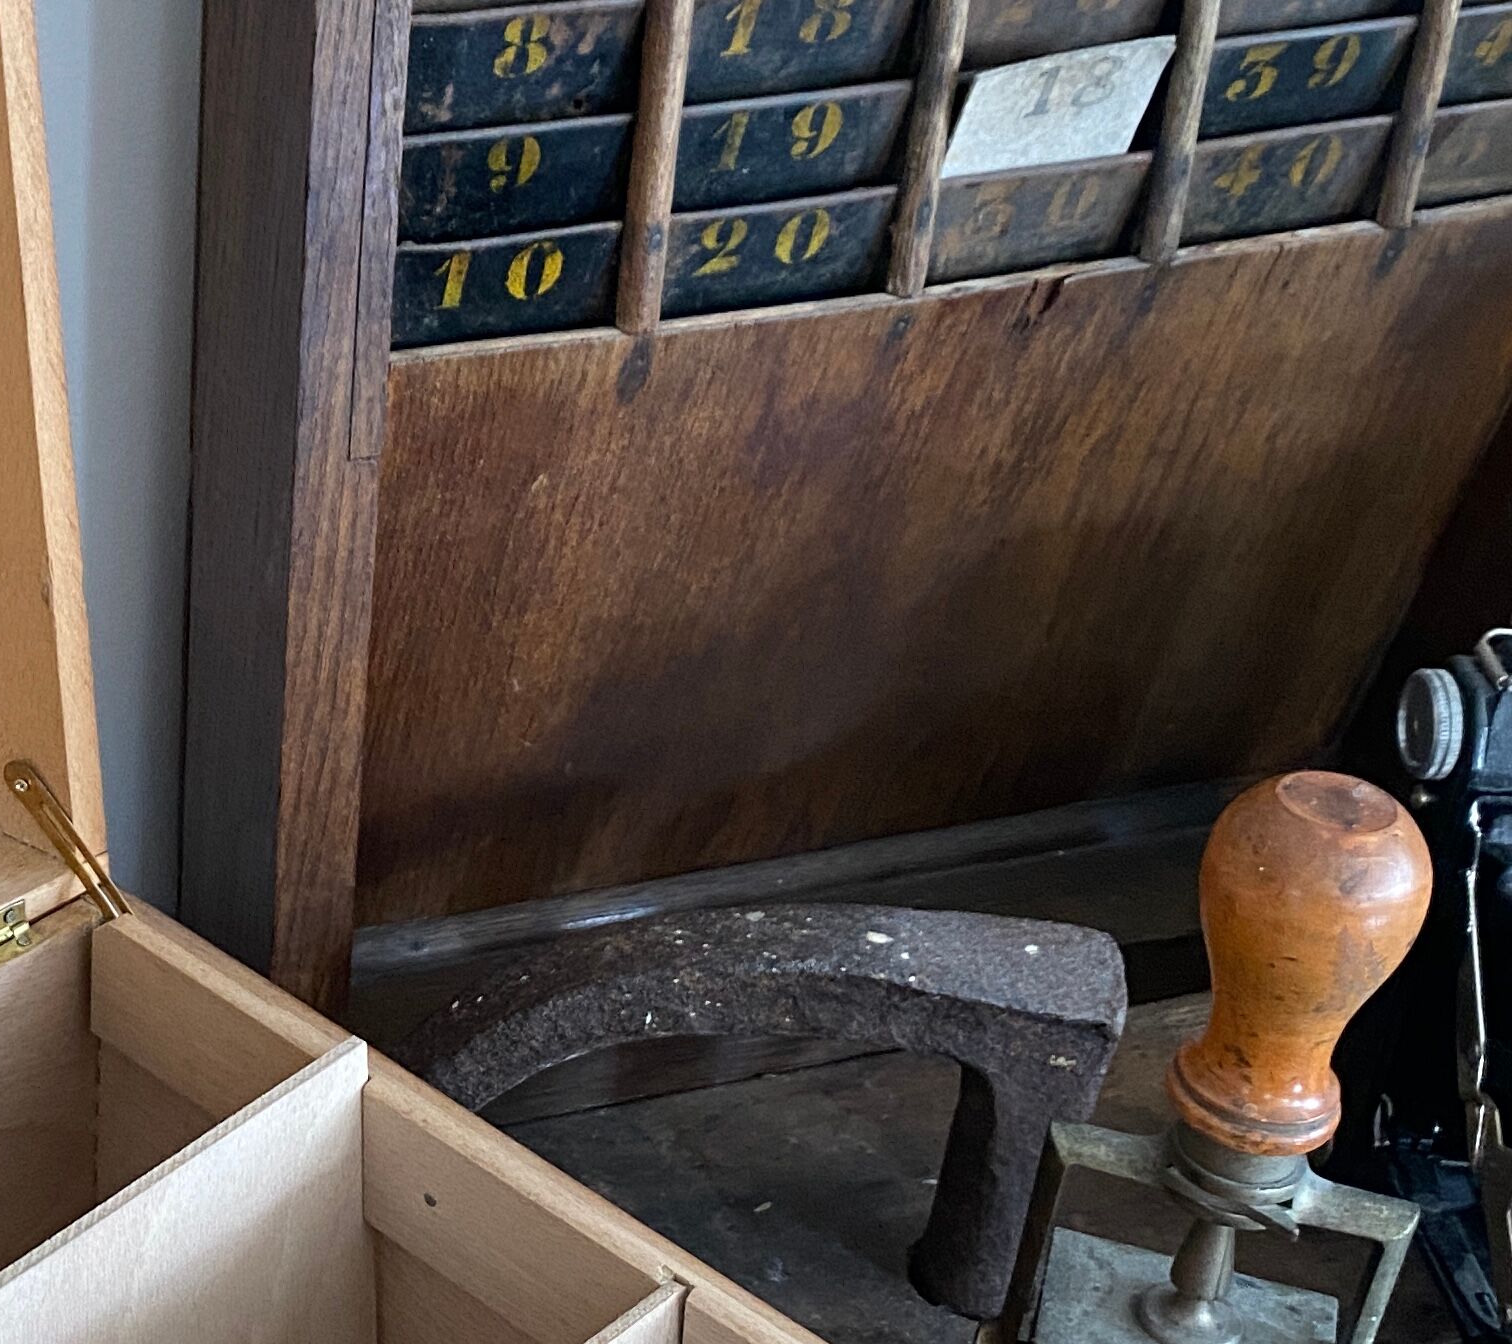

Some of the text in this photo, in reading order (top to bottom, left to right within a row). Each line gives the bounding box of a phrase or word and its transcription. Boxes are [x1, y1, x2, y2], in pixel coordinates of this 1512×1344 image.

[493, 12, 551, 79] 8
[1224, 33, 1362, 103] 39
[1023, 55, 1124, 119] 18
[488, 136, 542, 193] 9
[712, 101, 845, 174] 19
[1213, 134, 1344, 198] 40
[433, 241, 565, 311] 10
[692, 208, 831, 277] 20
